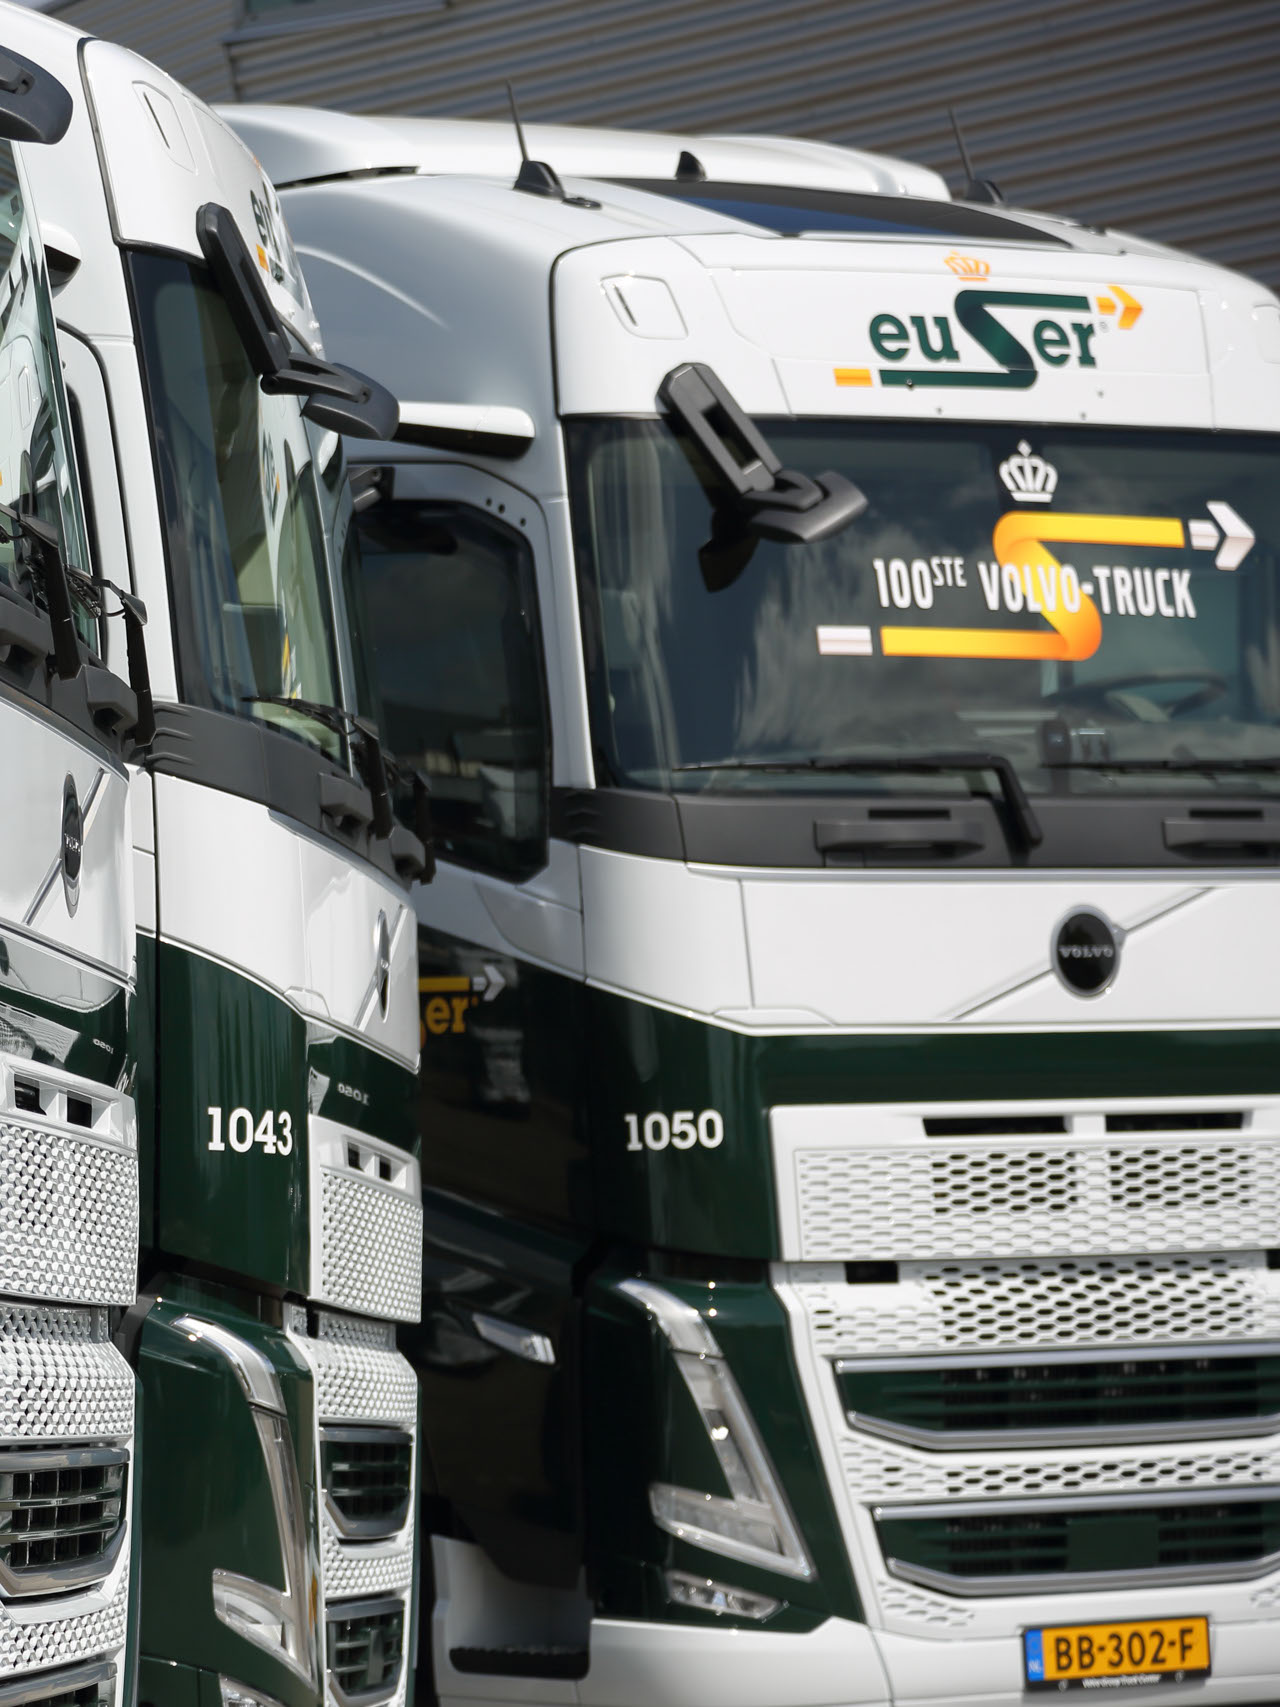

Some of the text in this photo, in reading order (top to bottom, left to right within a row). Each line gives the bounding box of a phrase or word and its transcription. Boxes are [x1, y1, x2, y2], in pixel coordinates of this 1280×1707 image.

[978, 560, 1197, 618] VOLVO-TRUCK
[1059, 944, 1114, 958] VOLVO
[207, 1106, 293, 1156] 1043
[624, 1108, 724, 1151] 1050
[1054, 1627, 1194, 1672] BB-302-F
